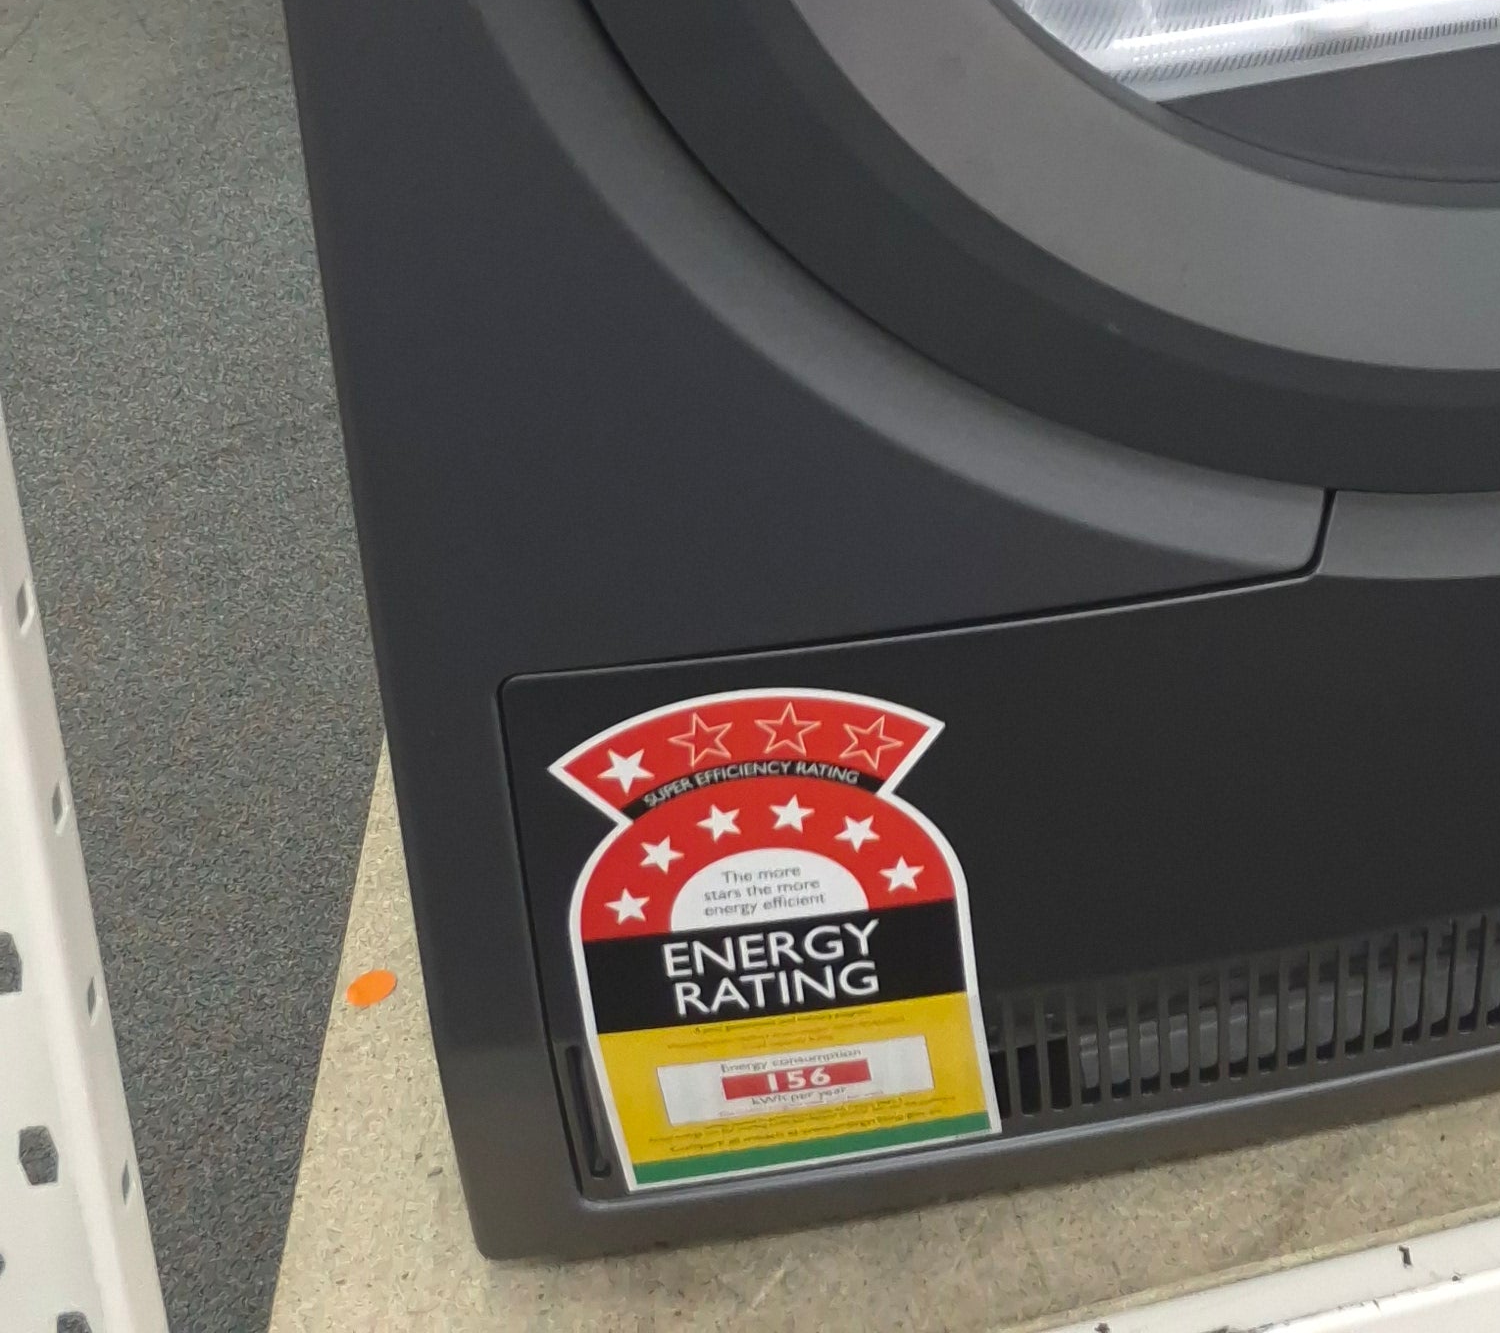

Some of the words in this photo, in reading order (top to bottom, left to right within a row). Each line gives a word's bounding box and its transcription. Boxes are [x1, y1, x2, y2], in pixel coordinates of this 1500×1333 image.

[643, 777, 694, 808] SUPER
[694, 760, 793, 787] EFFICIENCY
[795, 760, 860, 784] RATING
[722, 869, 753, 884] The
[758, 866, 802, 880] more
[703, 889, 742, 902] stars
[746, 884, 772, 897] the
[777, 879, 821, 893] more
[704, 901, 758, 917] energy
[763, 893, 827, 911] efficient
[661, 917, 881, 981] ENERGY
[674, 960, 881, 1018] RATING
[720, 1059, 769, 1075] Energy
[766, 1066, 833, 1093] 156
